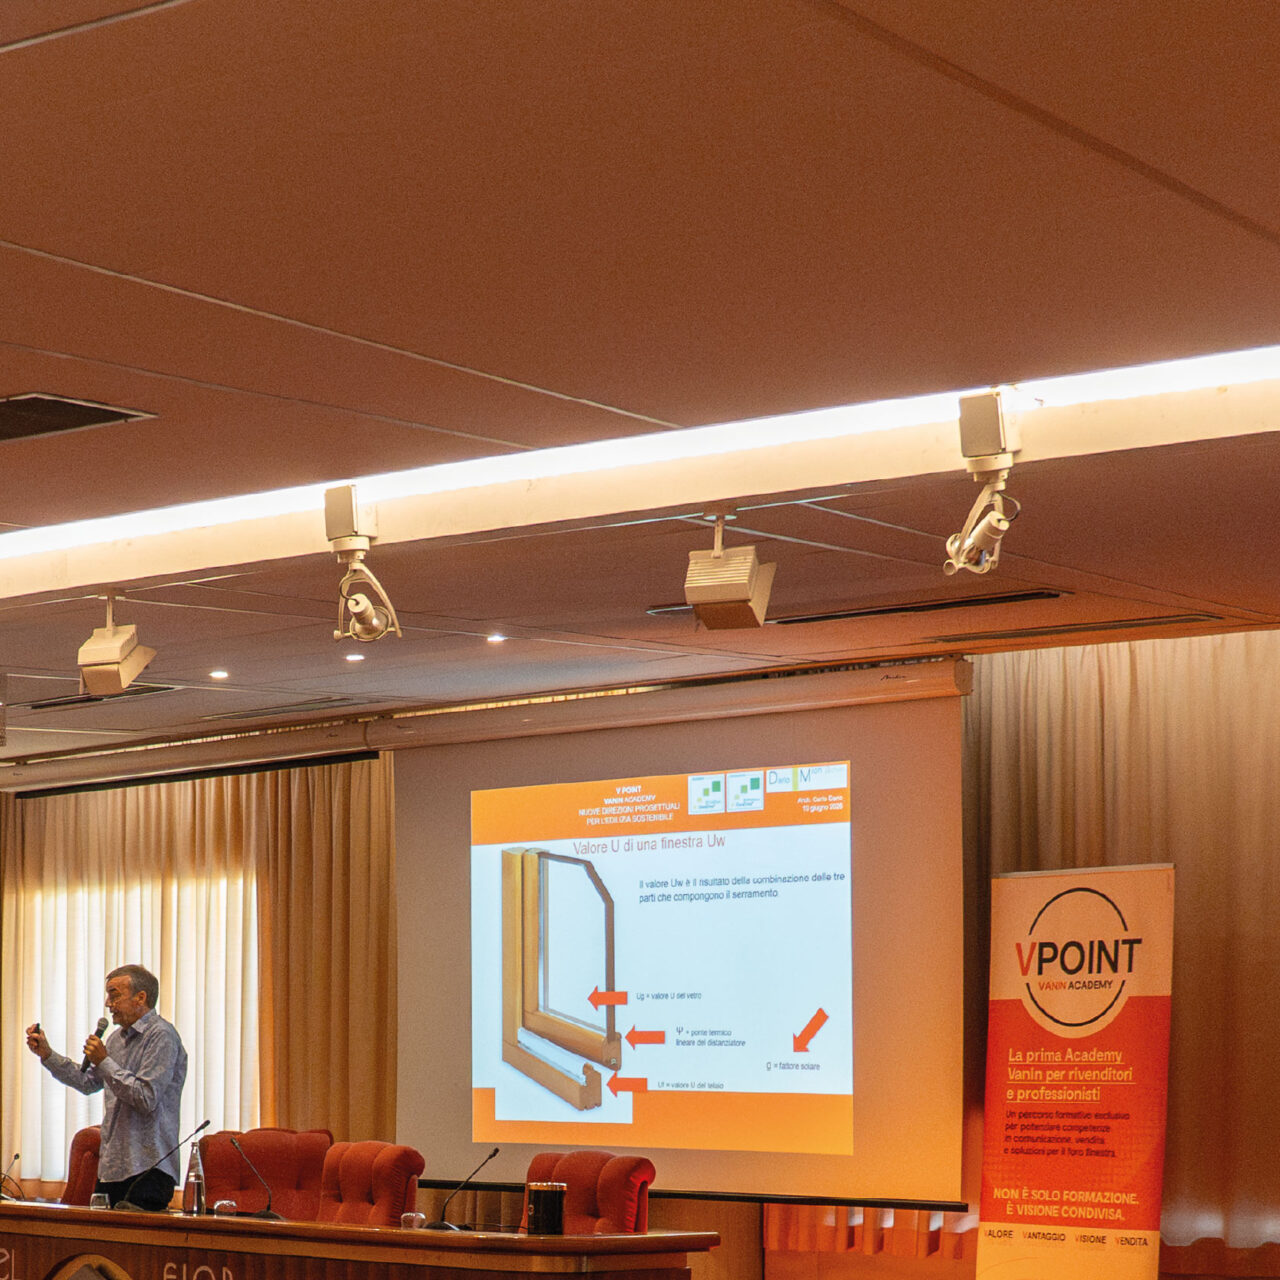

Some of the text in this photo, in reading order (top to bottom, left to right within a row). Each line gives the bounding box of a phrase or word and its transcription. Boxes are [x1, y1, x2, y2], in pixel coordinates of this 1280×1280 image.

[622, 785, 642, 794] POINT
[578, 807, 600, 816] NUOVE
[634, 802, 680, 812] PROGETTUALI
[586, 817, 600, 825] PER
[632, 813, 673, 823] SOSTENIBILE
[573, 834, 726, 855] Valore U di una finestra Uw
[645, 880, 669, 888] valore
[670, 878, 684, 888] Uw
[699, 877, 730, 886] risultato
[752, 874, 809, 884] combinazione
[833, 872, 846, 881] tre
[639, 893, 656, 904] parti
[657, 893, 672, 902] che
[673, 891, 725, 903] compongono
[732, 889, 779, 899] serramento
[1038, 980, 1113, 991] VANIN ACADEMY
[651, 992, 669, 1000] valore
[676, 1038, 746, 1047] lineare del distanziatore
[1008, 1048, 1122, 1064] La prima Academy
[779, 1061, 799, 1070] fattore
[800, 1062, 820, 1070] solare
[1008, 1067, 1133, 1083] Vanin per rivenditori
[696, 1081, 706, 1089] del
[1006, 1086, 1100, 1101] e professionisti
[1006, 1111, 1017, 1119] Un
[1018, 1111, 1054, 1120] percorso
[1055, 1111, 1092, 1119] formativo
[1005, 1123, 1111, 1133] per potenziare competenze
[993, 1186, 1139, 1205] NON È SOLO FORMAZIONE.
[1006, 1201, 1126, 1221] È VISIONE CONDIVISA.
[984, 1229, 1148, 1247] VALORE VANTAGGIO VISIONE VENDITA
